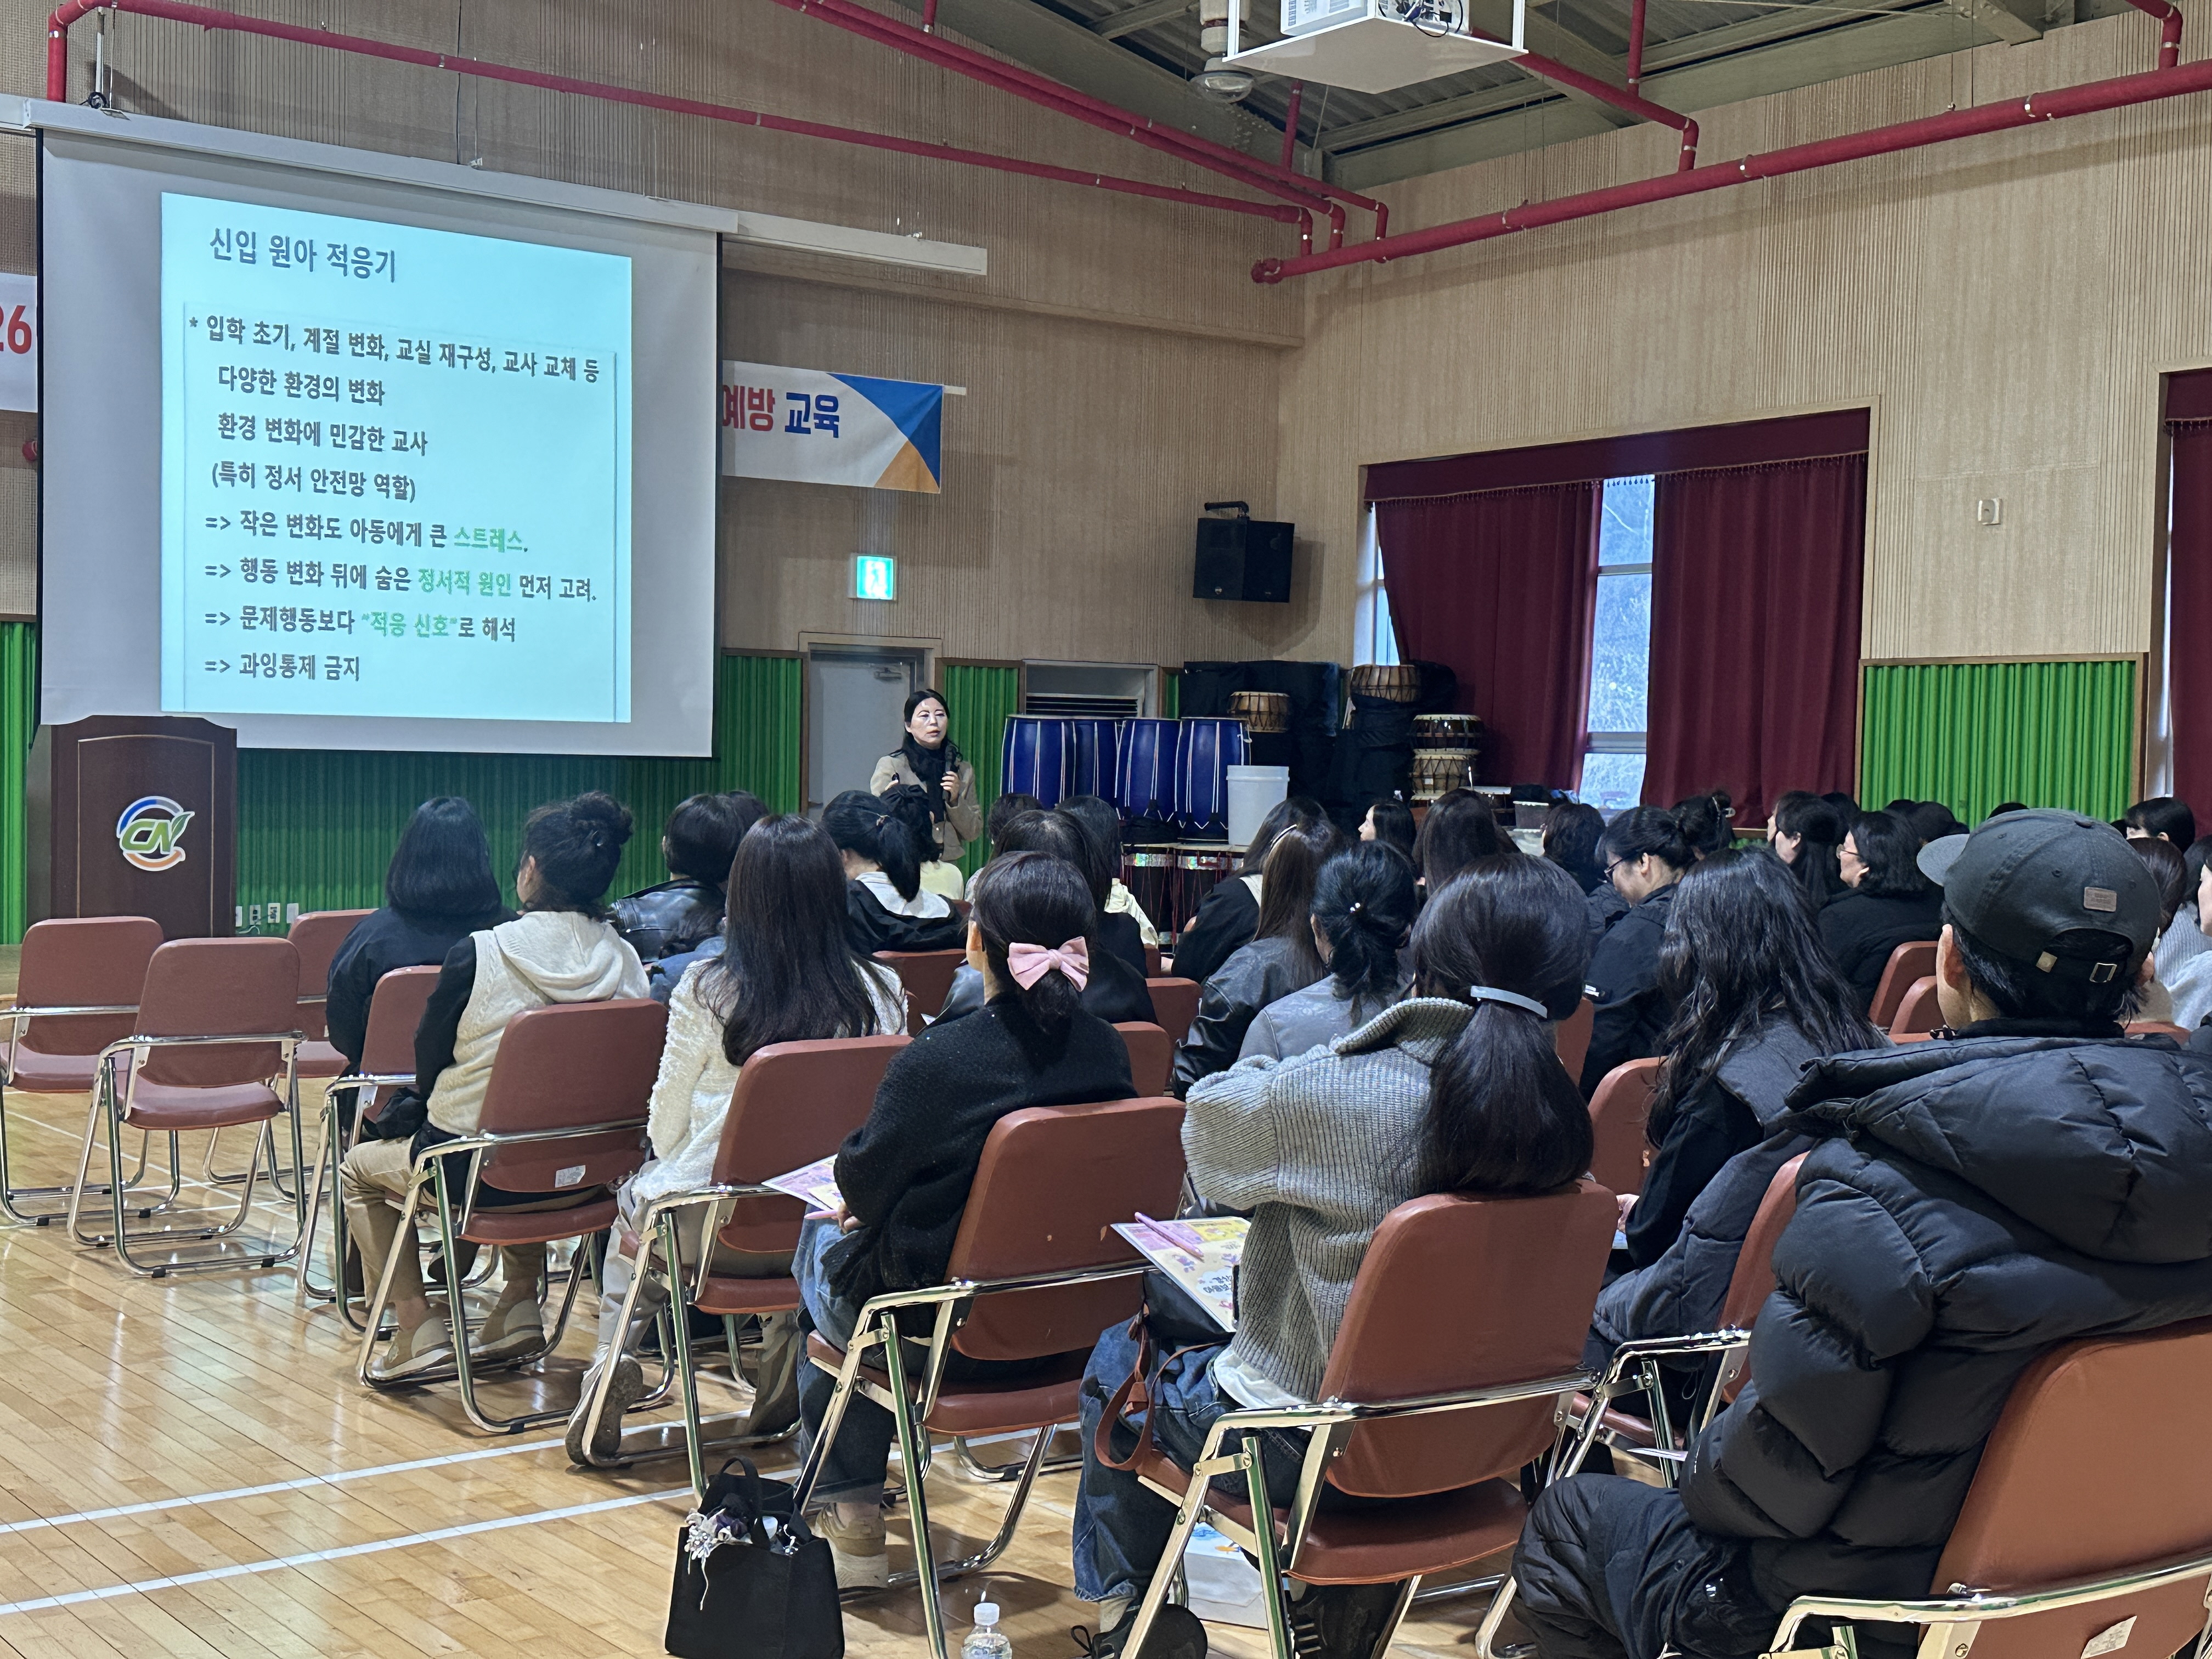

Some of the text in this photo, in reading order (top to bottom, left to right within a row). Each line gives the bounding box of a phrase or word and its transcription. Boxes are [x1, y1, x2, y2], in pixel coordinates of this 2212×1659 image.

[210, 228, 395, 283] 신입 원아 적응기
[0, 305, 32, 354] 6
[207, 315, 246, 345] 입학
[252, 321, 296, 351] 초기,
[303, 328, 340, 355] 계절
[348, 333, 390, 362] 변화,
[396, 338, 431, 365] 교실
[439, 343, 495, 374] 재구성,
[503, 351, 539, 377] 교사
[544, 356, 576, 381] 교체
[584, 359, 600, 383] 등
[219, 365, 386, 406] 다양한 환경의 변화
[722, 384, 839, 438] 예방 교육
[218, 412, 428, 456] 환경 변화에 민감한 교사
[212, 461, 415, 503] (특히 정서 안전망 역할)
[240, 510, 278, 537] 작은
[286, 514, 343, 540] 변화도
[350, 518, 421, 547] 아동에게
[430, 524, 447, 548] 큰
[454, 527, 528, 552] 스트레스.
[240, 557, 278, 584] 행동
[286, 560, 324, 587] 변화
[330, 563, 366, 590] 뒤에
[375, 566, 412, 591] 숨은
[418, 568, 470, 595] 정서적
[477, 572, 511, 596] 원인
[520, 575, 551, 600] 먼저
[559, 578, 597, 602] 고려.
[239, 606, 355, 635] 문제행동보다
[482, 617, 515, 642] 해석
[239, 652, 315, 680] 과잉통제
[324, 656, 359, 681] 금지
